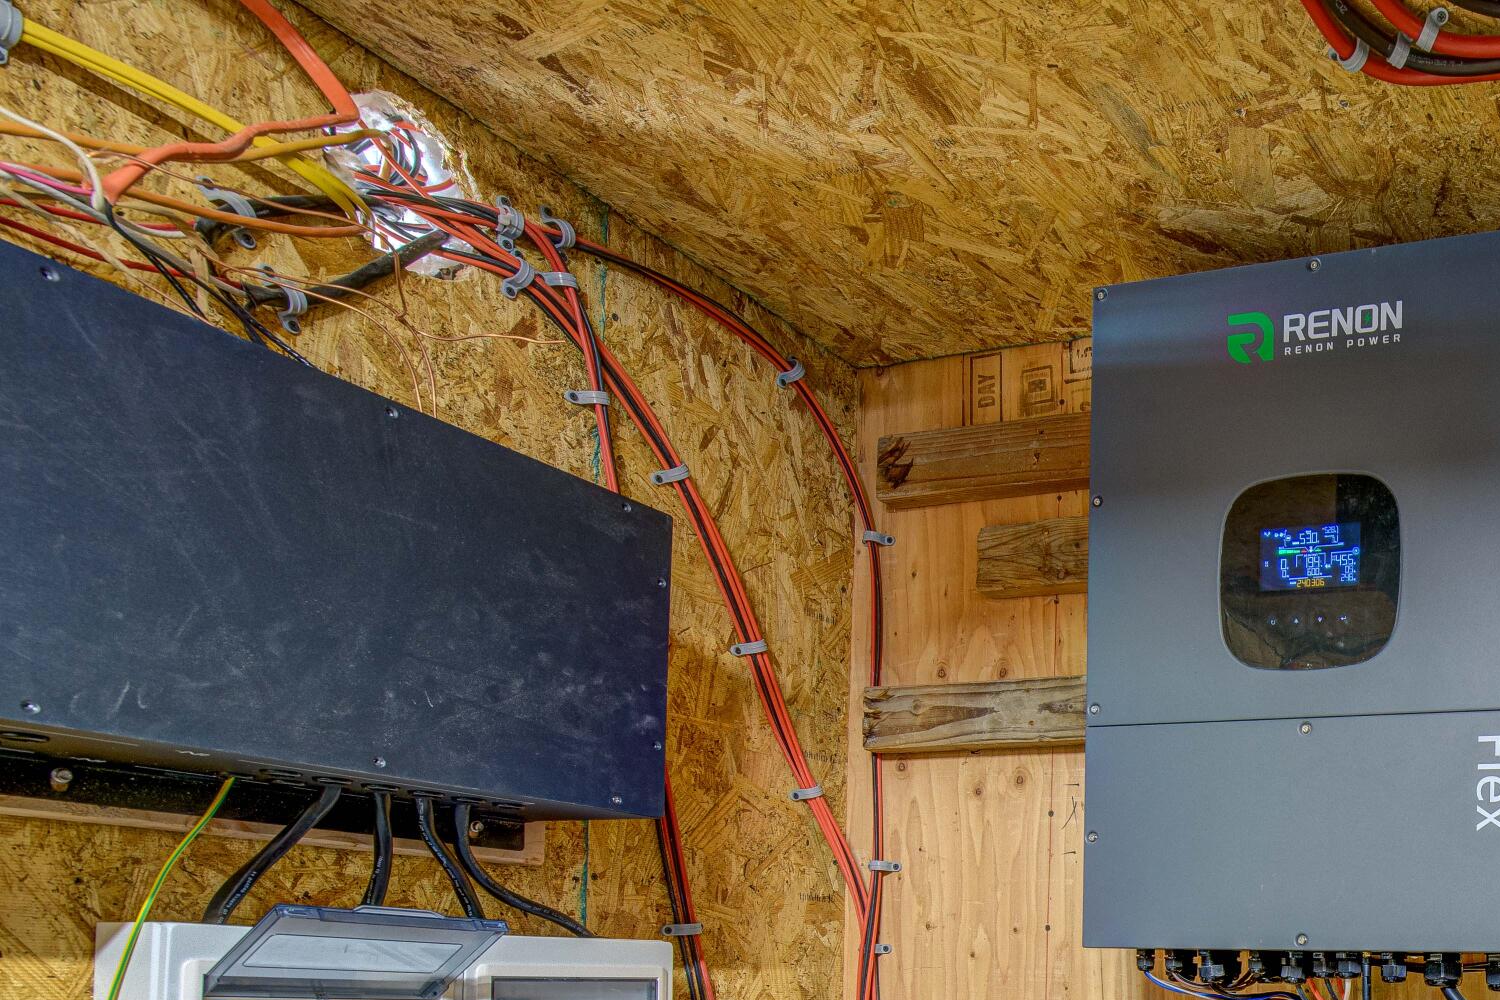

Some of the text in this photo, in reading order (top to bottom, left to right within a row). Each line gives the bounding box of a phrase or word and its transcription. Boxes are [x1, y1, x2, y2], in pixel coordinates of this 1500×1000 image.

[1283, 300, 1403, 343] RENON
[1284, 333, 1401, 356] RENON POWER
[978, 374, 996, 409] DAY
